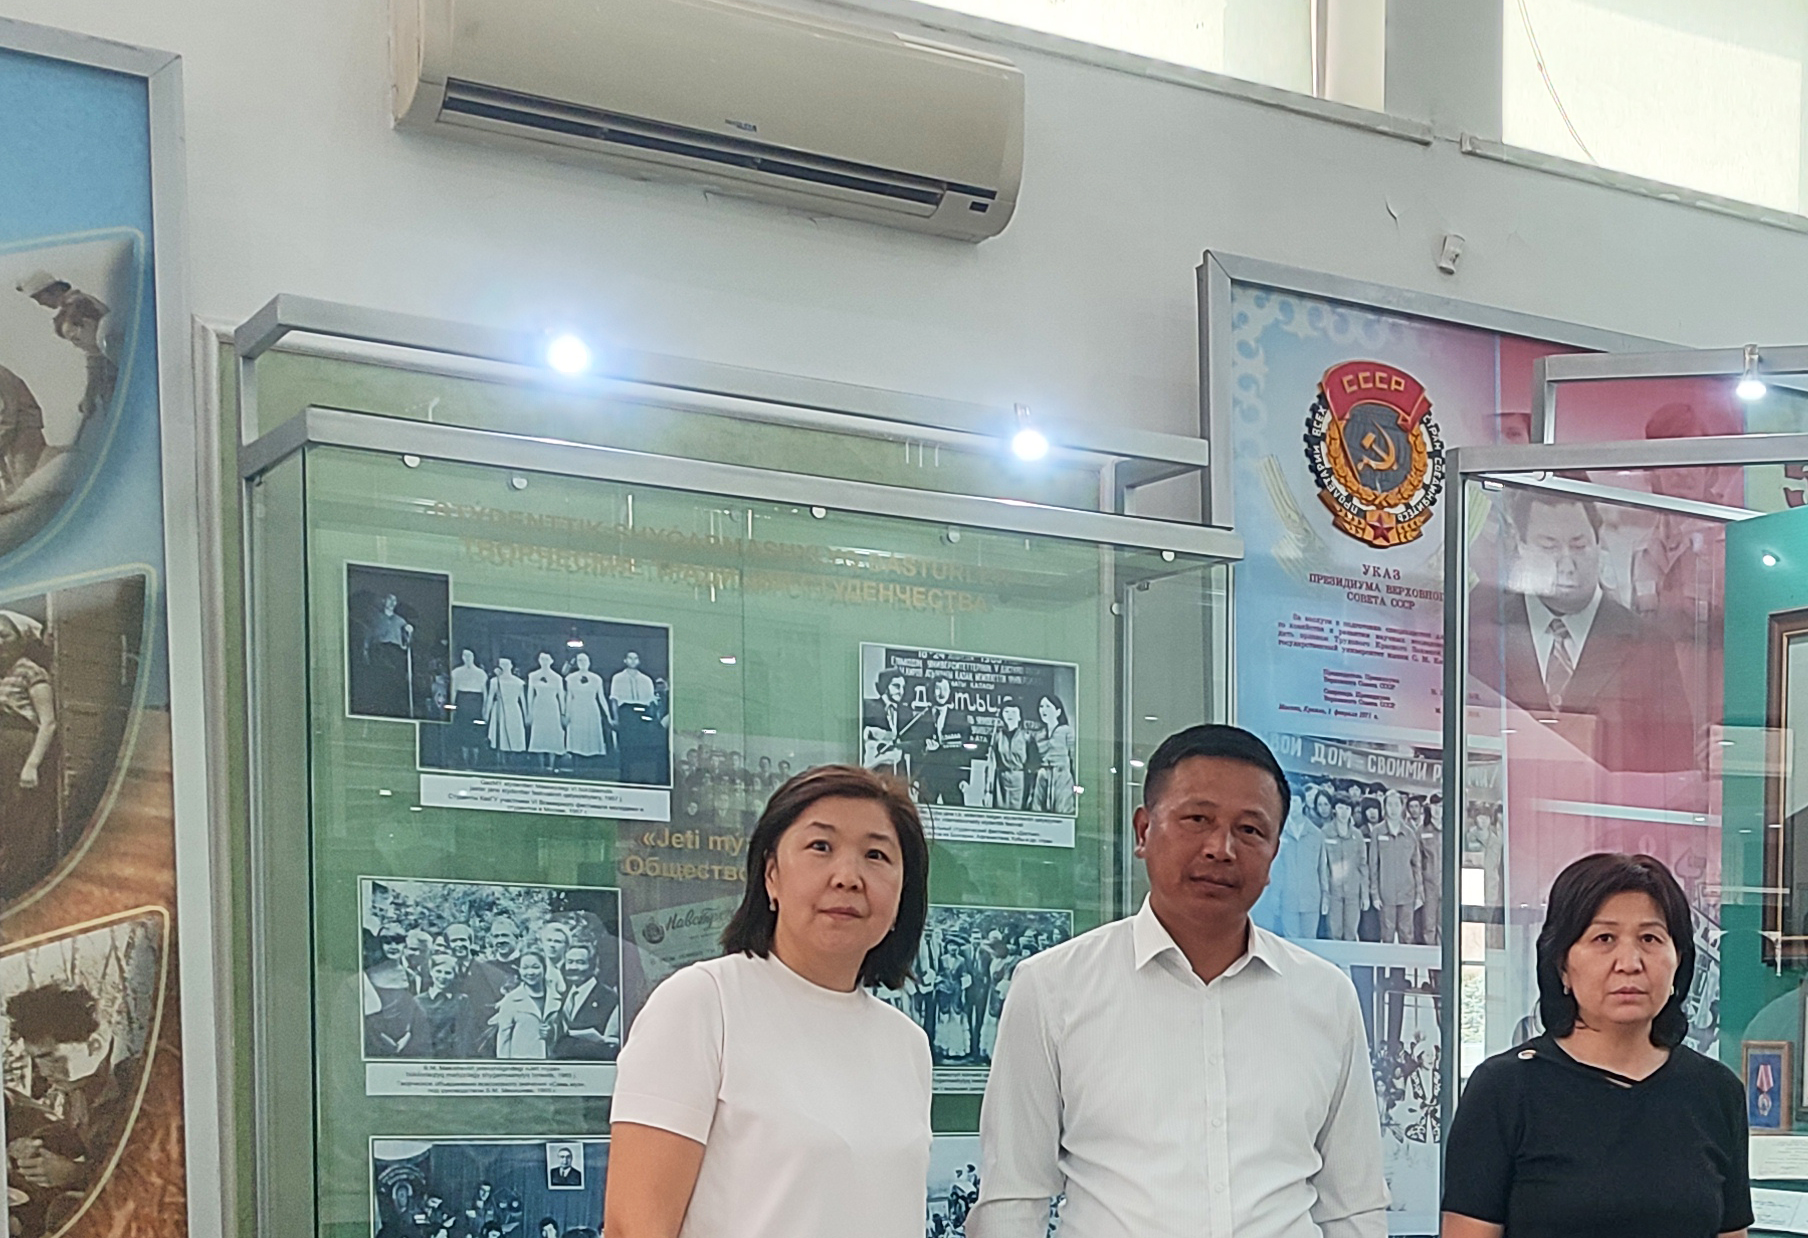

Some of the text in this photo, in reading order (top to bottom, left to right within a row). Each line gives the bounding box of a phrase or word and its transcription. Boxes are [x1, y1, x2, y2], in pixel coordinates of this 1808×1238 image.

[1341, 372, 1405, 394] СССР
[1311, 405, 1327, 437] ВСЕХ
[1423, 415, 1442, 450] СТРАН
[1362, 563, 1402, 581] УКАЗ
[1309, 573, 1444, 602] ПРЕЗИДИУМА ВЕРХОВНОГ
[1346, 591, 1415, 610] СОВЕТА СССР
[1310, 742, 1352, 769] ДОМ
[1367, 755, 1427, 781] СВОИМИ
[642, 828, 700, 850] «Jeti
